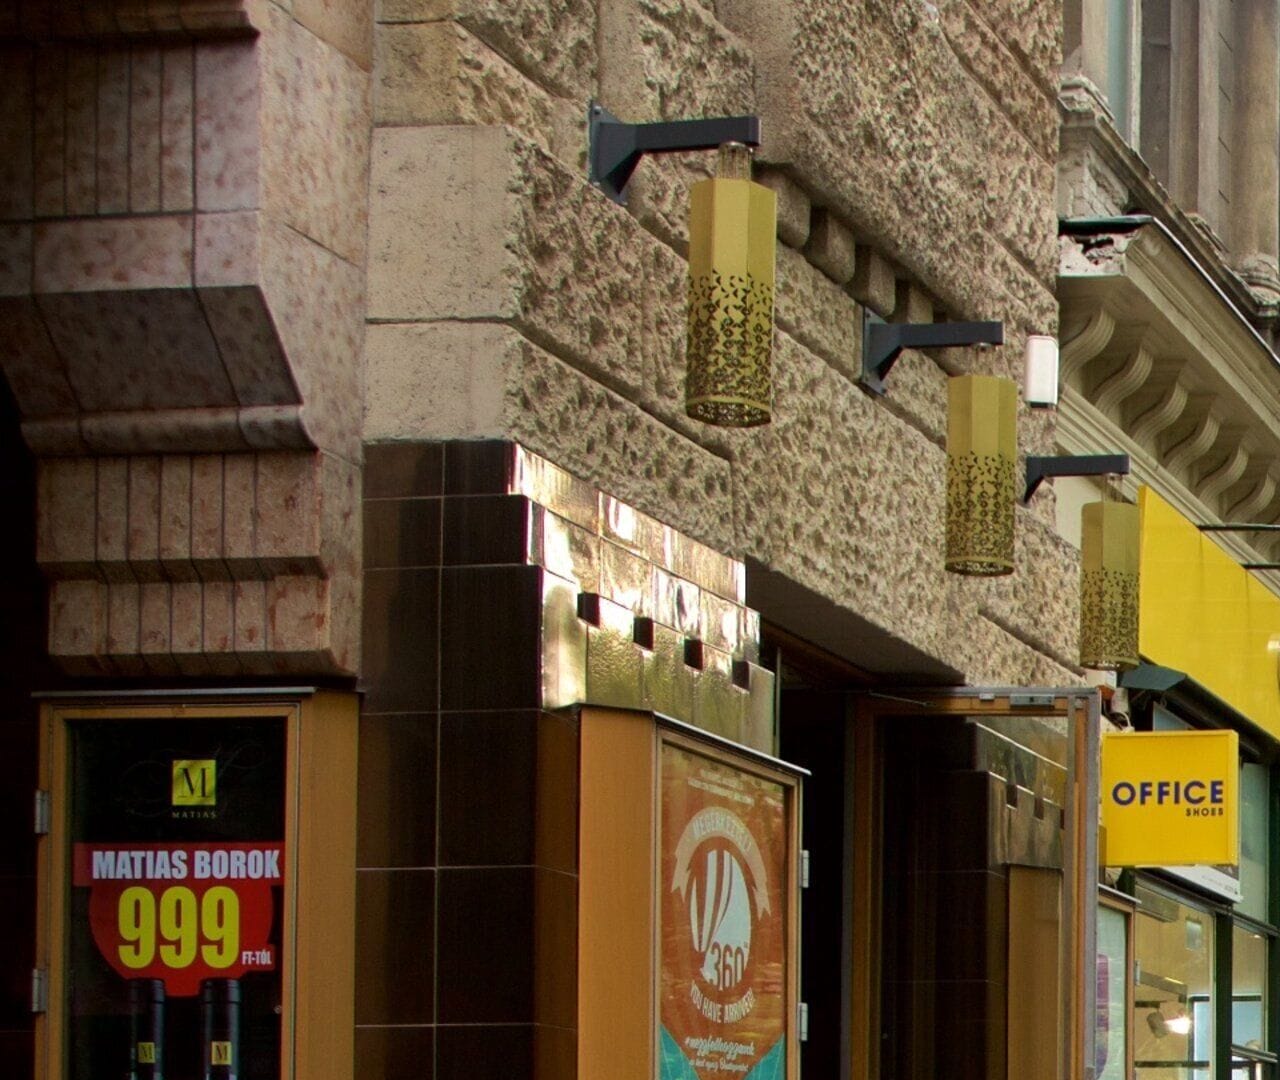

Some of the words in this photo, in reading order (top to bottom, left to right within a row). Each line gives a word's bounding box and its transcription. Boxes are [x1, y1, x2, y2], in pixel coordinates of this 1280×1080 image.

[178, 767, 212, 799] M
[1112, 780, 1223, 806] OFFICE
[172, 811, 218, 819] MATIAS
[1185, 808, 1223, 817] SHOES
[92, 851, 188, 879] MATIAS
[194, 850, 280, 879] BOROK
[118, 886, 240, 968] 999
